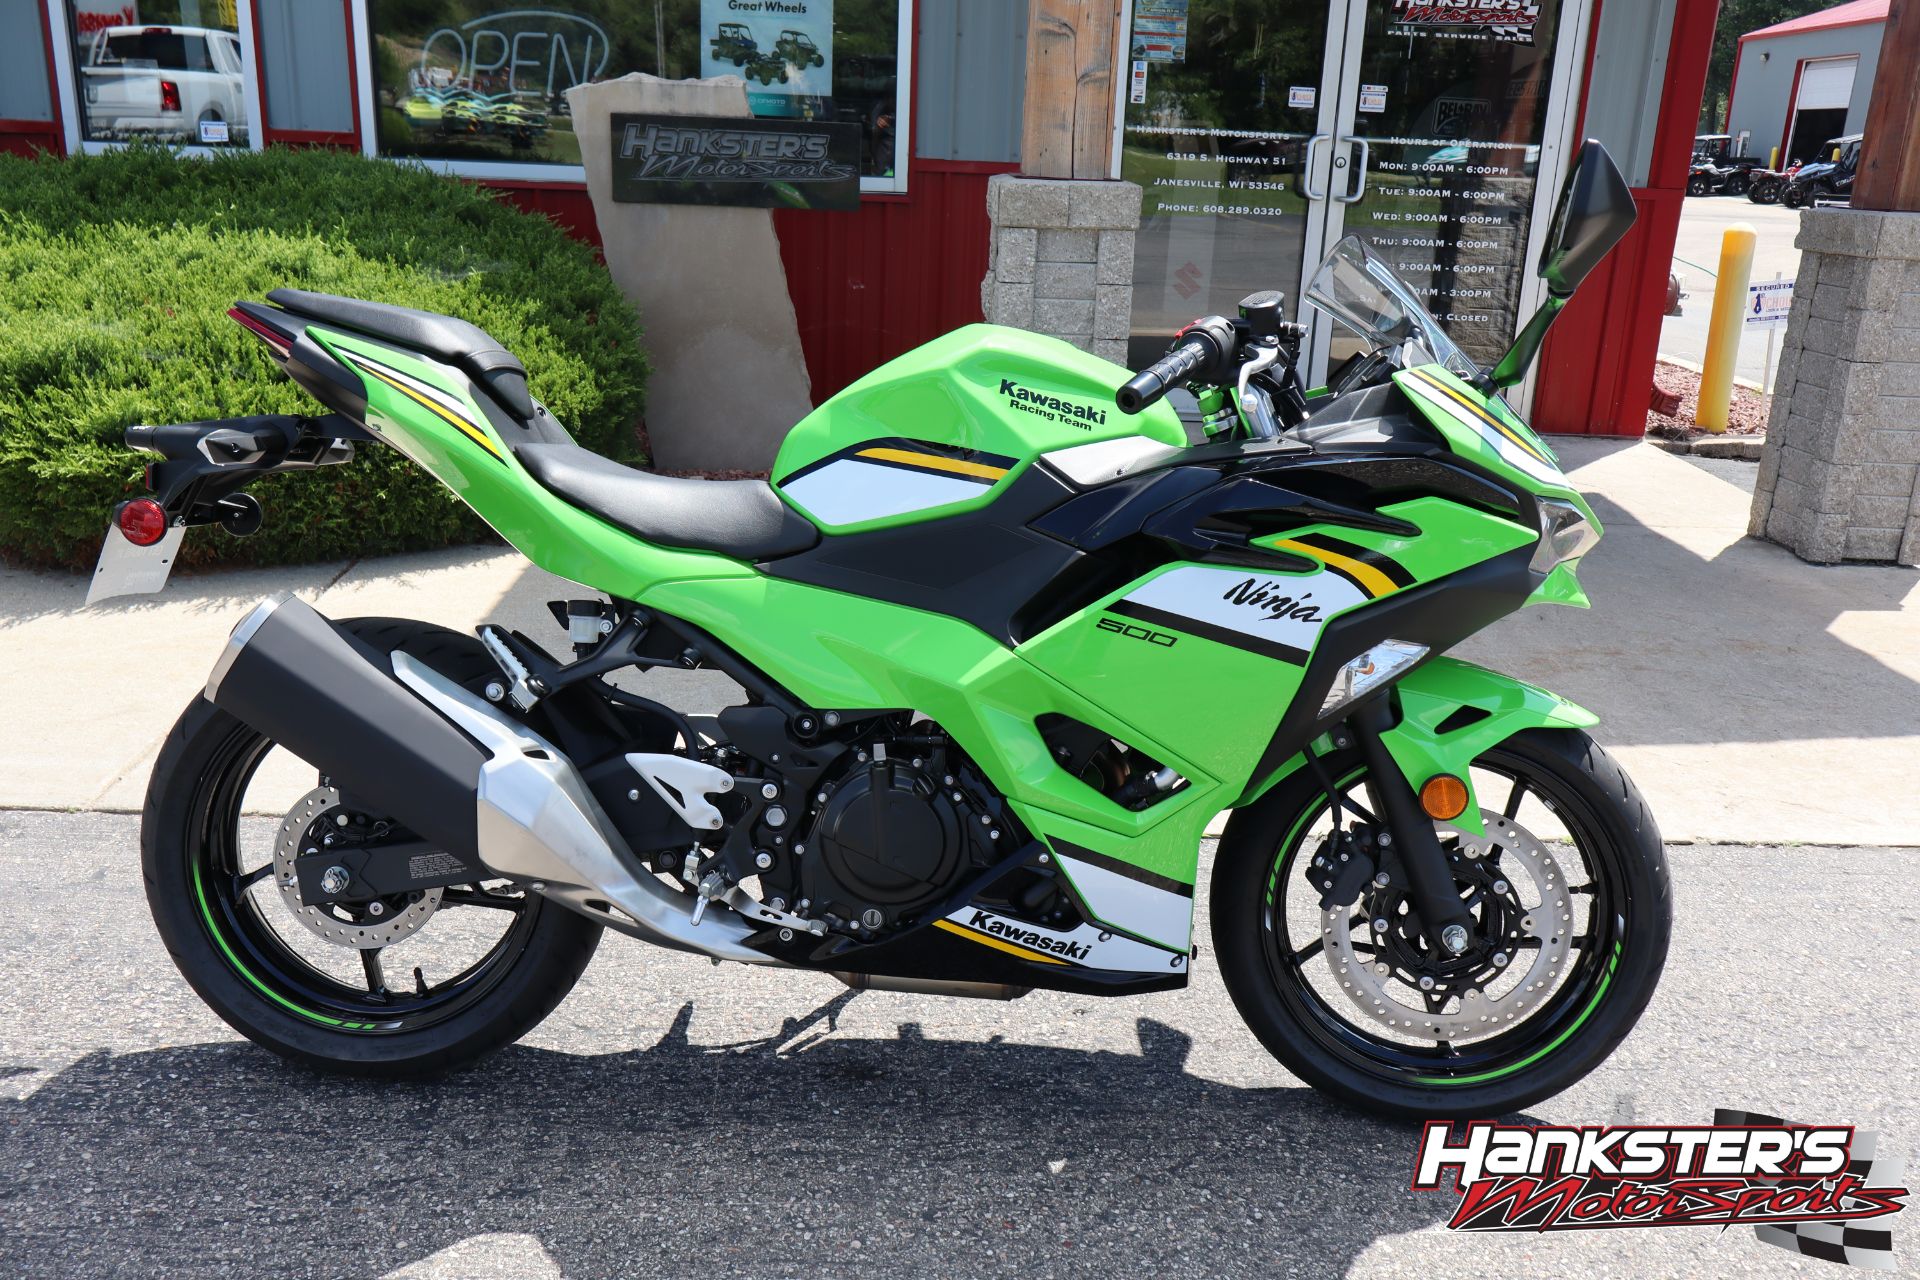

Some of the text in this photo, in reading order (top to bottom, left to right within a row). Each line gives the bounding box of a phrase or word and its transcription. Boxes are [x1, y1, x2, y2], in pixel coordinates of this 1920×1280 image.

[728, 0, 807, 14] Great Wheels
[1435, 32, 1489, 40] SERVICE
[421, 28, 594, 96] OPEN
[1390, 136, 1513, 150] HOURS OF OPERATION
[1166, 152, 1286, 166] 6319 S. HIGHWAY 51
[1379, 161, 1407, 171] MON:
[1411, 163, 1455, 173] 9:00AM
[1466, 165, 1509, 175] 6:00PM
[1154, 177, 1284, 191] JANESVILLE, WI 53546
[1378, 187, 1404, 196] TUE:
[1408, 188, 1451, 198] 9:00AM
[1462, 190, 1505, 200] 6:00PM
[1157, 202, 1282, 216] PHONE: 608.289.0320
[1372, 212, 1401, 221] WED:
[1405, 213, 1448, 223] 9:00AM
[1459, 215, 1502, 225] 6:00PM
[1372, 236, 1398, 245] THU:
[1401, 238, 1445, 247] 9:00AM
[1456, 240, 1498, 249] 6:00PM
[1399, 263, 1441, 272] 9:00AM
[1452, 264, 1495, 273] 6:00PM
[1449, 289, 1492, 298] 3:00PM
[1446, 314, 1489, 322] CLOSED
[999, 378, 1107, 425] Kawasaki
[1009, 399, 1092, 431] Racing Team
[1222, 578, 1323, 622] Ninja
[1095, 617, 1178, 648] 500
[968, 910, 1093, 960] Kawasaki
